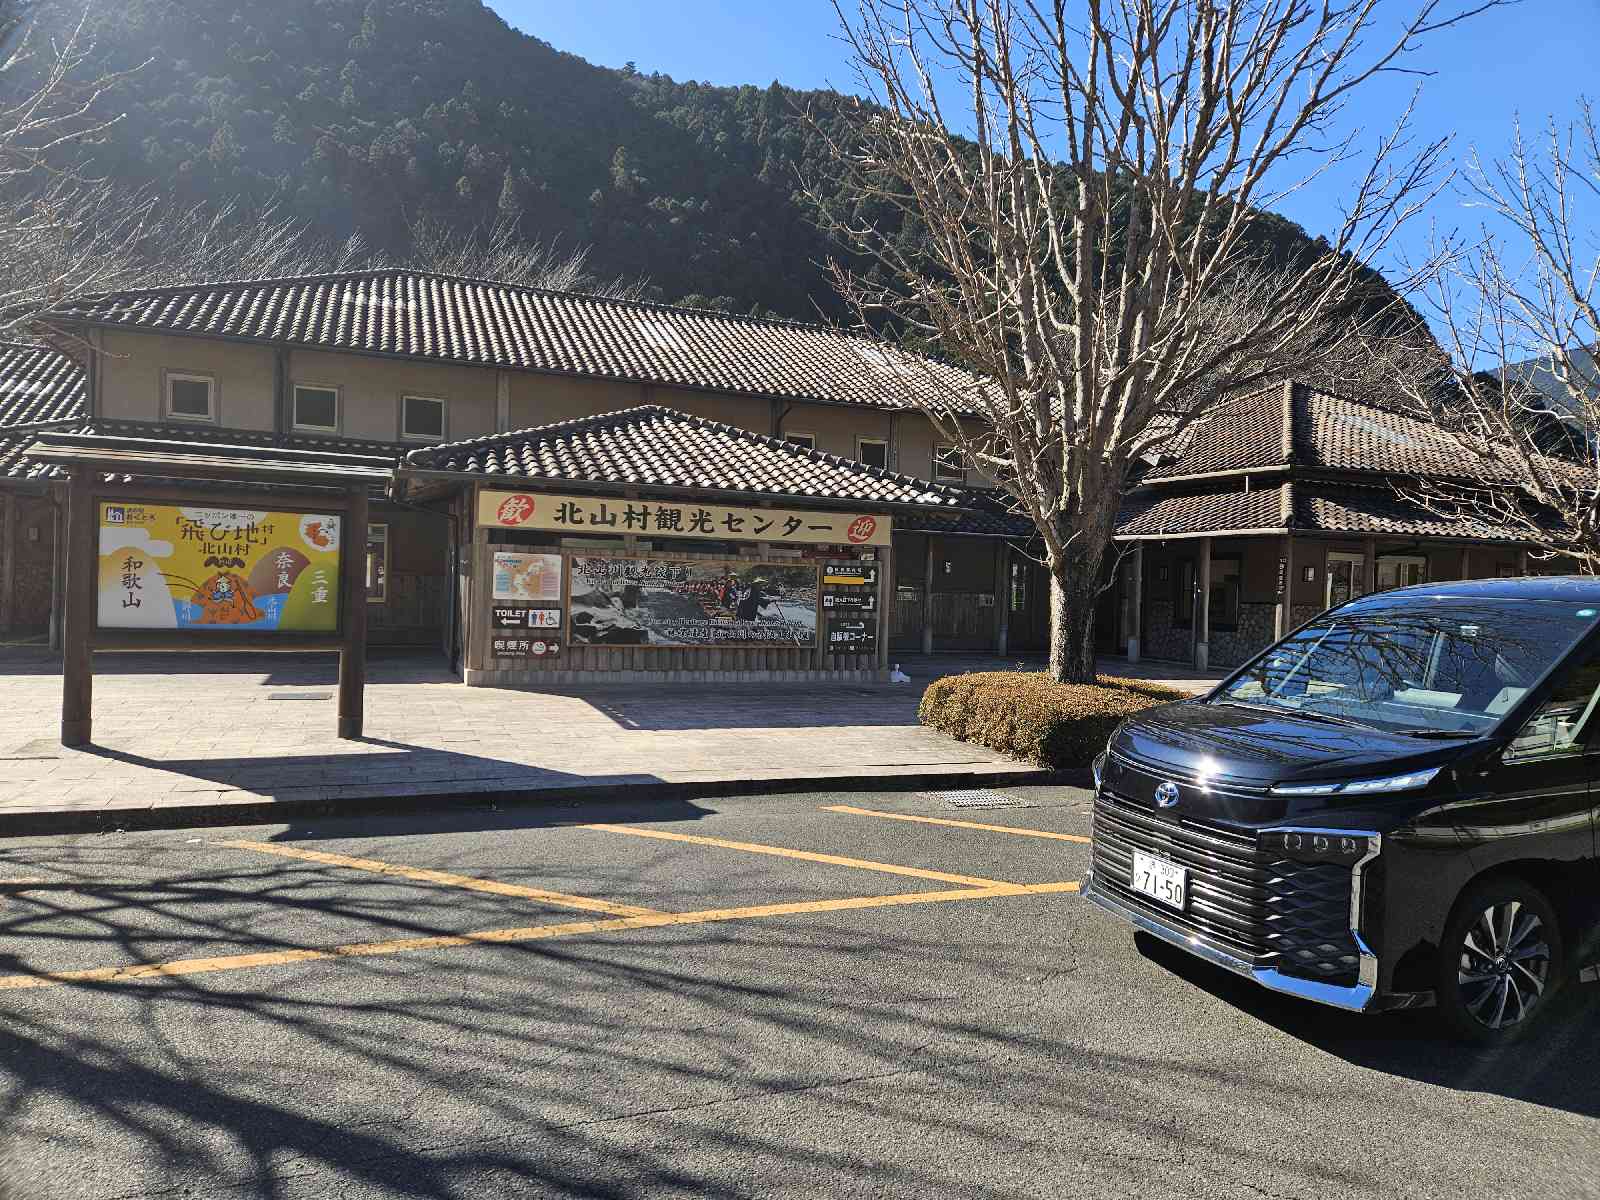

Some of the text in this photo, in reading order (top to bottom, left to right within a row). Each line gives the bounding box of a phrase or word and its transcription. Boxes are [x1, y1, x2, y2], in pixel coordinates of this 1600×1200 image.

[498, 495, 529, 522] 歓
[553, 501, 833, 537] 北山村観光センター
[198, 542, 249, 556] 北山村
[121, 556, 143, 609] 和歌山
[275, 552, 294, 589] 奈良
[310, 569, 328, 604] 三重
[495, 609, 527, 617] TOILET
[1143, 870, 1183, 904] 71-50
